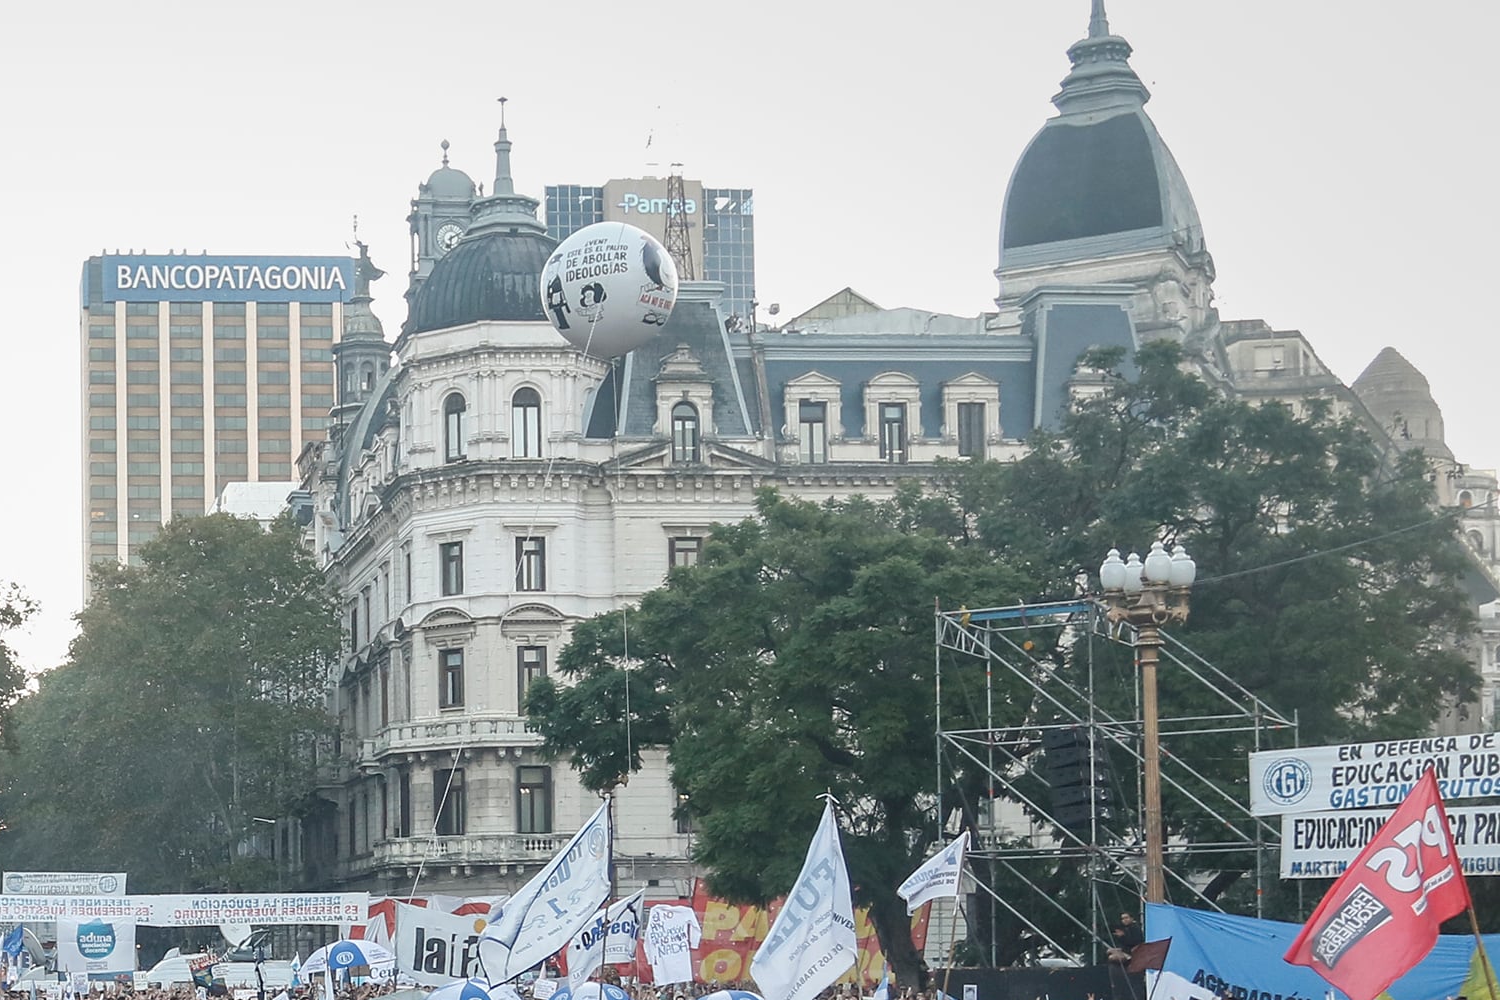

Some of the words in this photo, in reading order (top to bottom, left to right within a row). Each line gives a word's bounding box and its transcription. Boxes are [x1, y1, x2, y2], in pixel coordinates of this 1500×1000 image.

[617, 193, 696, 218] Pampa
[566, 258, 578, 269] DE
[582, 251, 627, 265] ABOLLAR
[117, 264, 347, 290] BANCOPATAGONIA
[565, 262, 628, 283] IDEOLOGÍAS
[1338, 745, 1362, 762] EN
[1374, 737, 1458, 757] DEFENSA
[1469, 733, 1495, 750] DE
[1438, 777, 1500, 799] RUTOS
[80, 931, 112, 943] aduna
